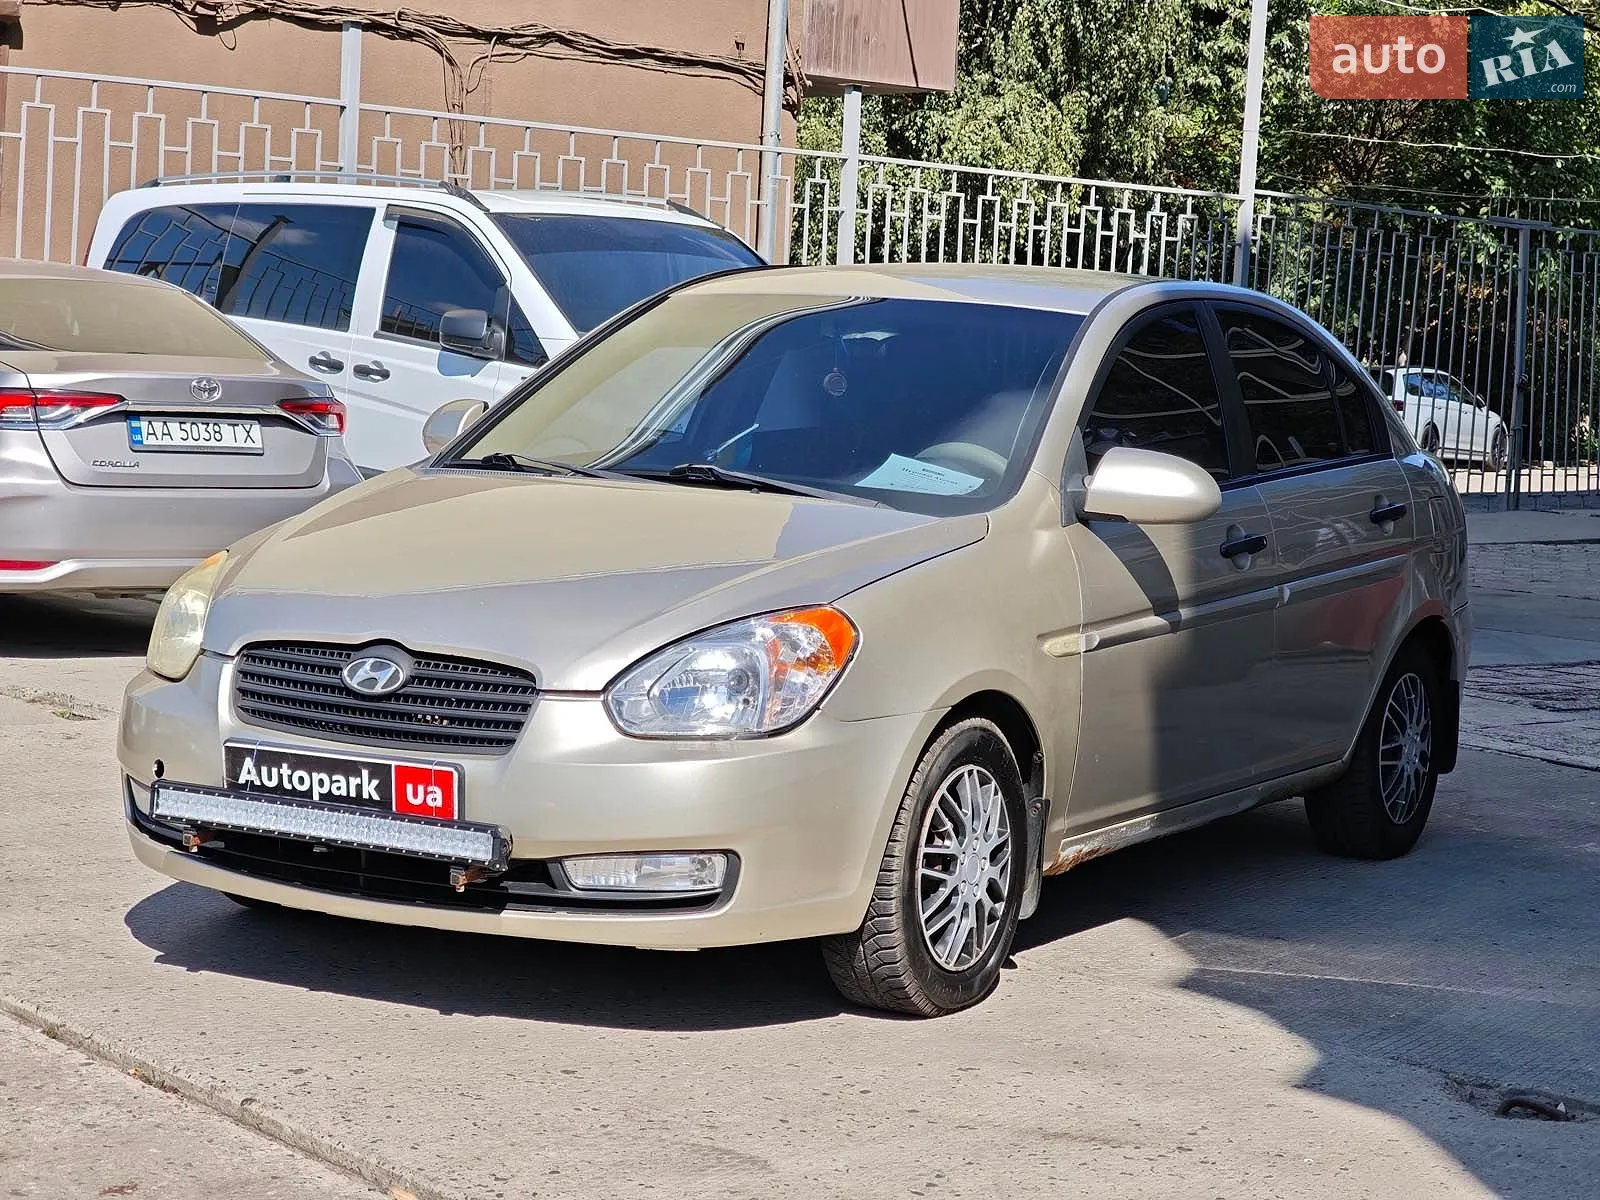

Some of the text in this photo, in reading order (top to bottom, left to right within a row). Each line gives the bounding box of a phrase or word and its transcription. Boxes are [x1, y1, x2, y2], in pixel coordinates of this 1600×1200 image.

[146, 421, 256, 444] AA 5038 TX
[92, 460, 140, 468] COROLLA
[238, 757, 443, 807] Autopark ua
